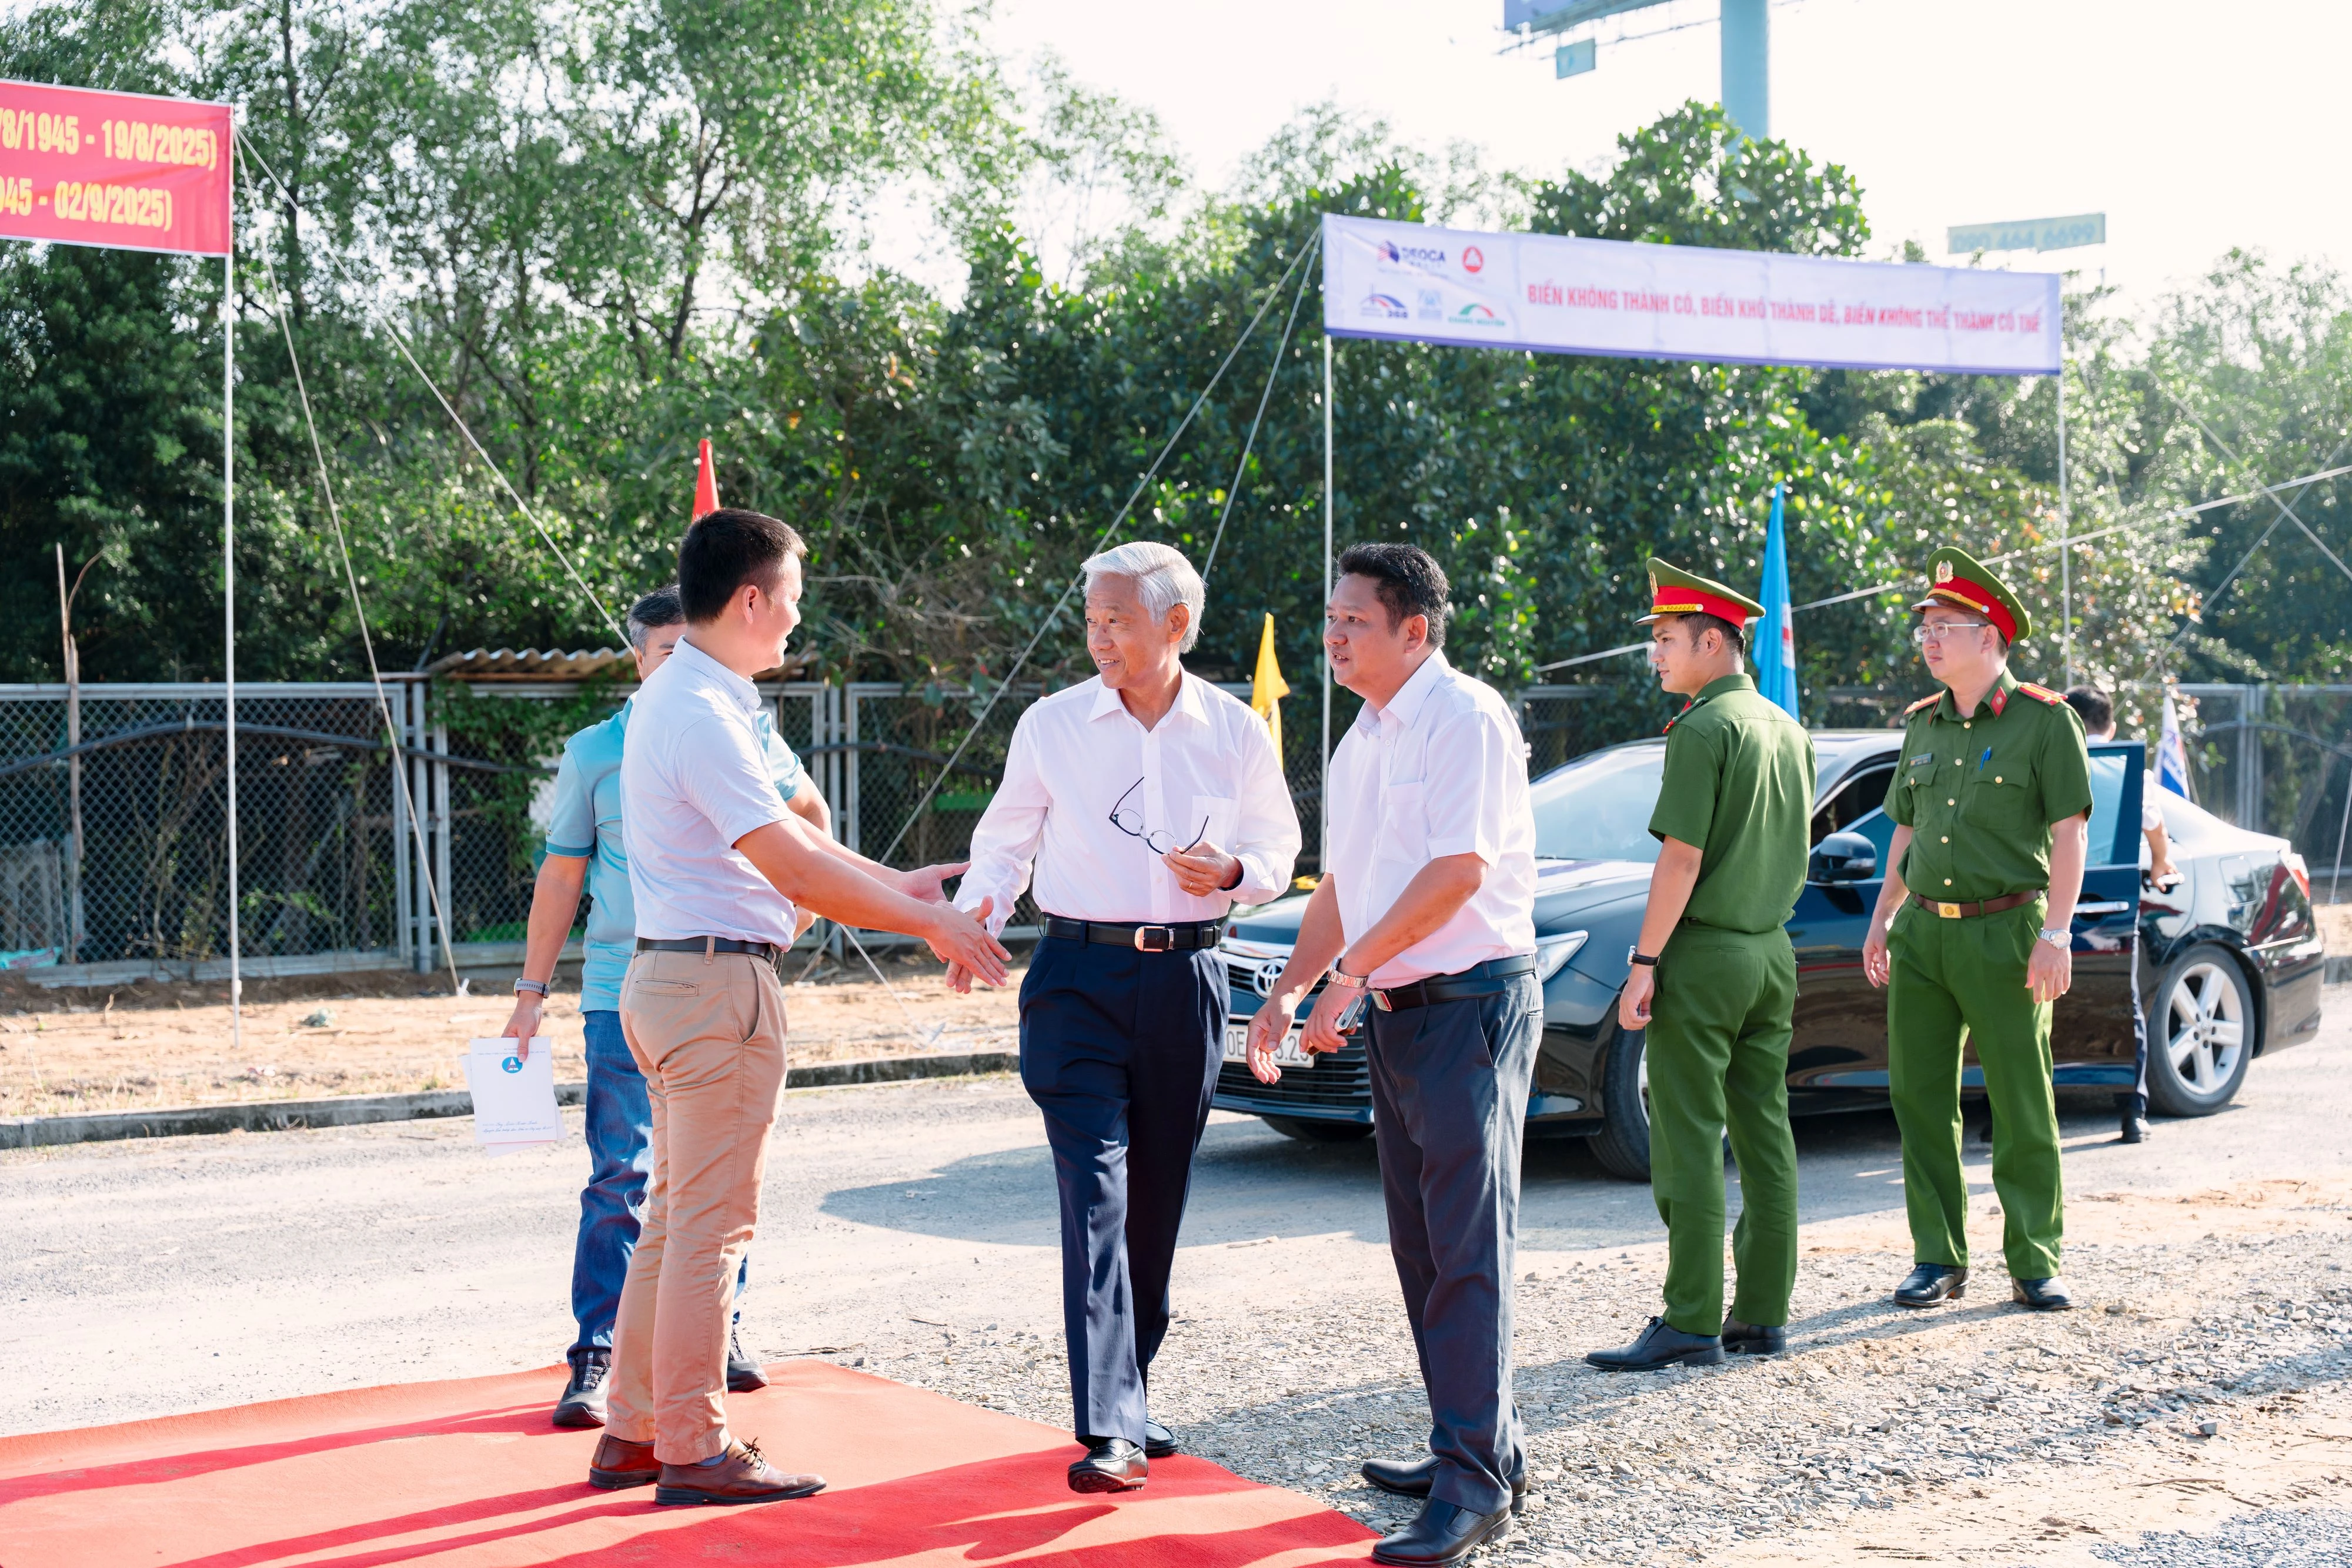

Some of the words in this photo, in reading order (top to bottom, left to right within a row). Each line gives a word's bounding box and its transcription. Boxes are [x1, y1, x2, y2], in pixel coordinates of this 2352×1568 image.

[85, 134, 95, 145] -
[101, 119, 218, 171] 19/8/2025)
[38, 196, 48, 206] -
[54, 180, 172, 232] 02/9/2025)
[1567, 282, 1618, 310] KHÔNG
